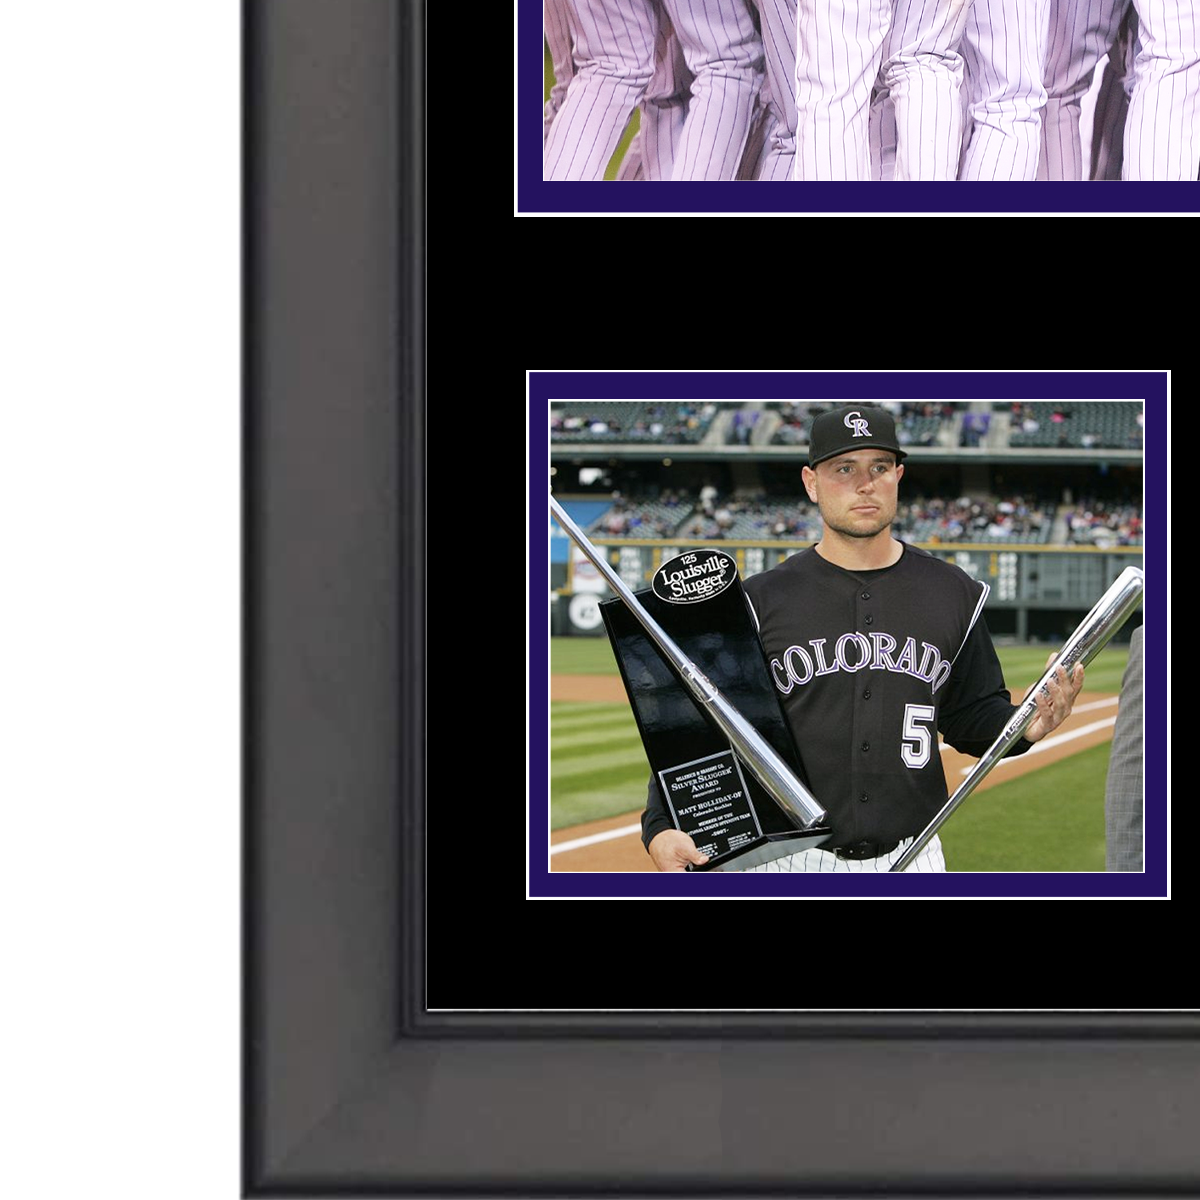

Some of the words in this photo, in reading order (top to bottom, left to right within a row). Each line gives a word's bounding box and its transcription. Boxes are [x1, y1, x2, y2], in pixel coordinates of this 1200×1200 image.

[660, 555, 730, 586] Louisville
[680, 553, 698, 565] 125
[770, 631, 952, 694] COLORADO
[900, 703, 935, 769] 5
[671, 777, 698, 791] SILVER
[697, 767, 733, 783] SLUGGER
[691, 779, 719, 793] AWARD
[678, 805, 697, 816] MATT
